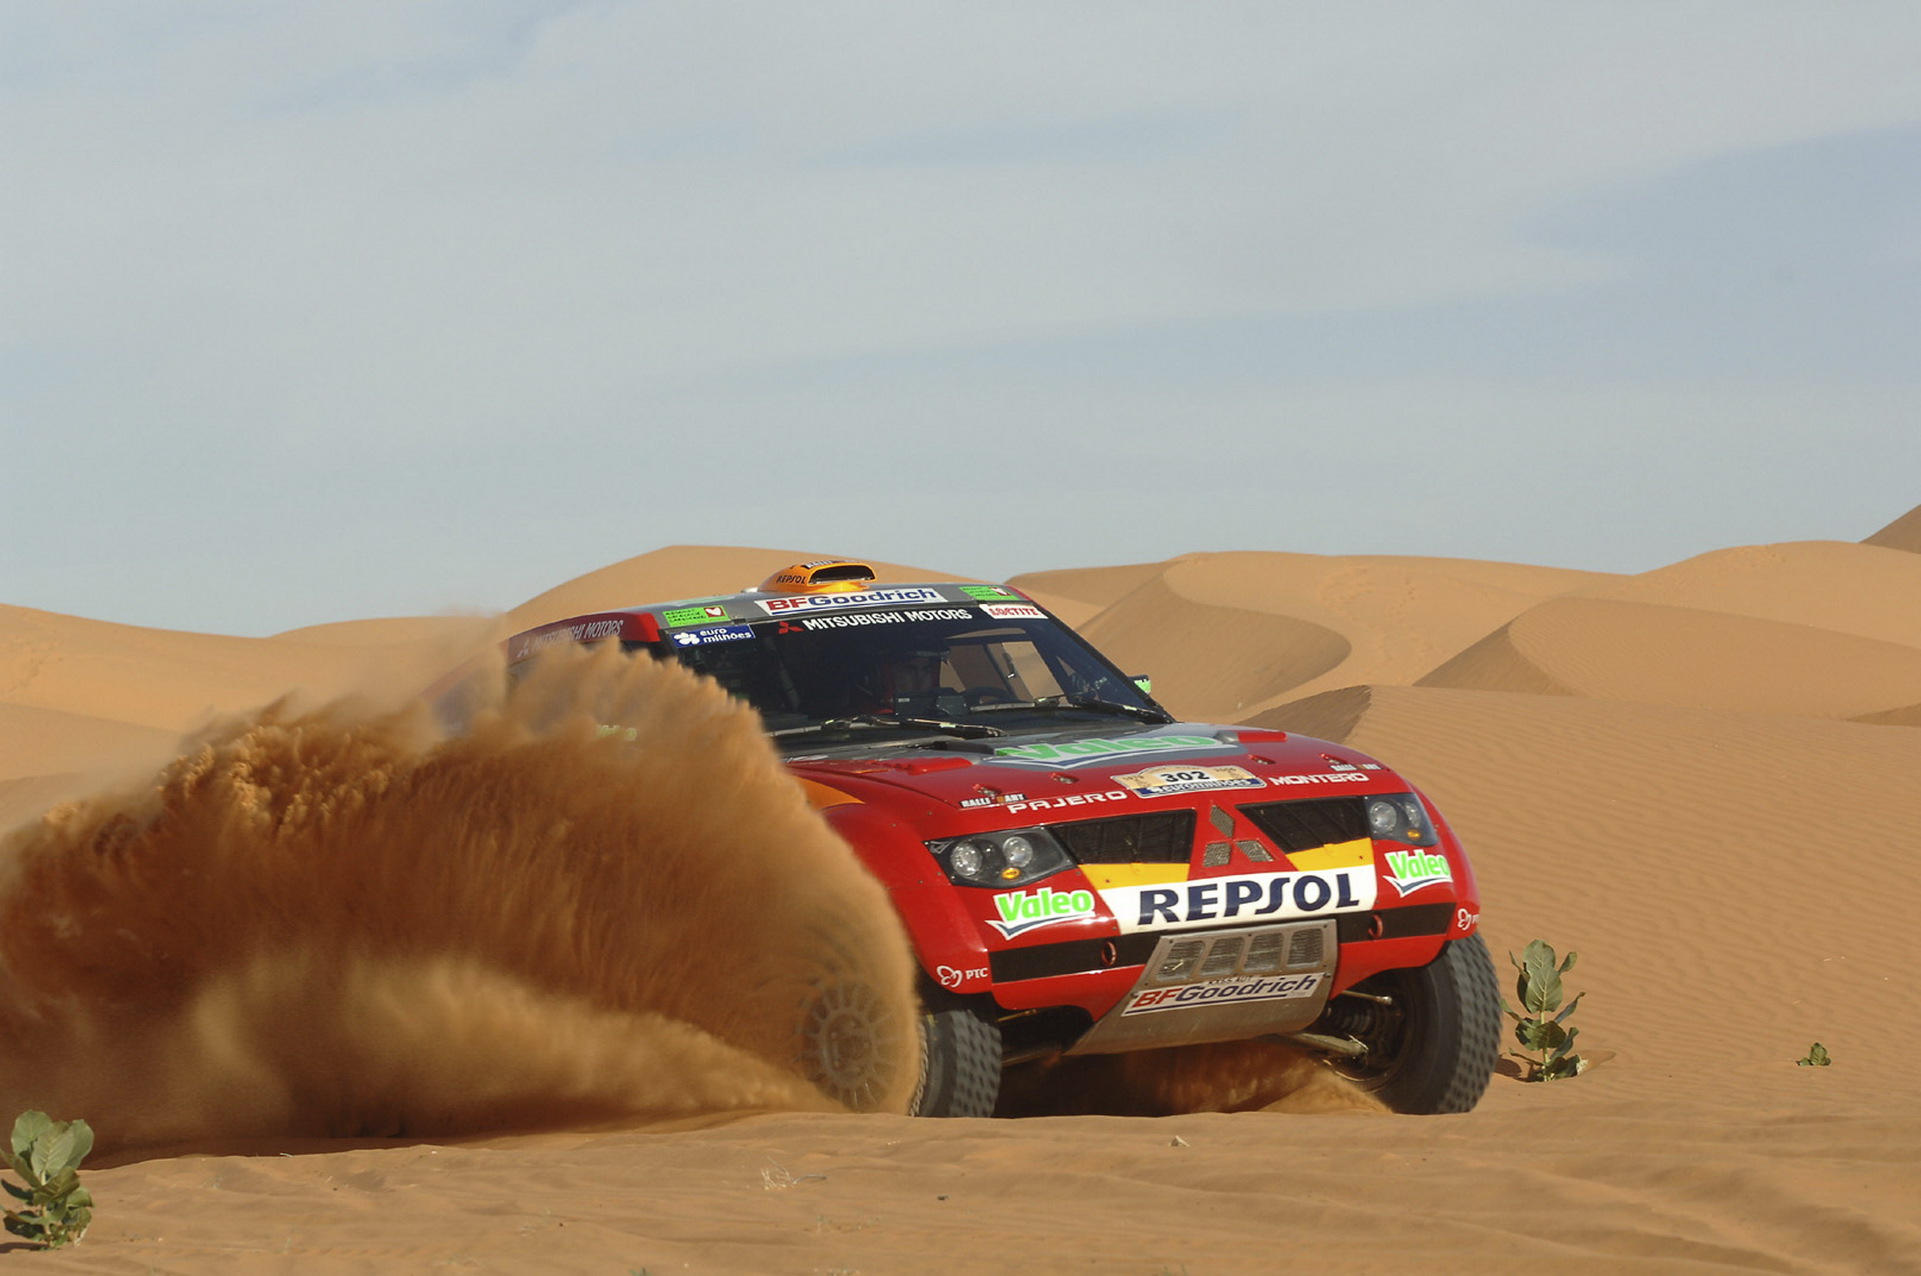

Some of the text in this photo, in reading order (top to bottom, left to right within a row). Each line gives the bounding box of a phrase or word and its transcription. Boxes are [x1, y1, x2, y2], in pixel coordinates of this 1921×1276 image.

[776, 575, 806, 584] REPSOL
[766, 589, 936, 611] BFGoodrich
[802, 608, 973, 631] MITSUBISHI MOTORS
[988, 607, 1040, 616] LOCTITE
[583, 620, 624, 639] MOTORS
[700, 628, 727, 636] euro
[996, 736, 1217, 759] Valeo
[1160, 771, 1210, 782] 302
[1268, 772, 1370, 786] MONTERO
[1007, 790, 1128, 814] PAJERO
[1389, 852, 1450, 880] Valeo
[997, 890, 1092, 922] Valeo
[1137, 873, 1359, 926] REPSOL
[966, 968, 988, 980] PTC
[1132, 975, 1317, 1008] BFGoodrich
